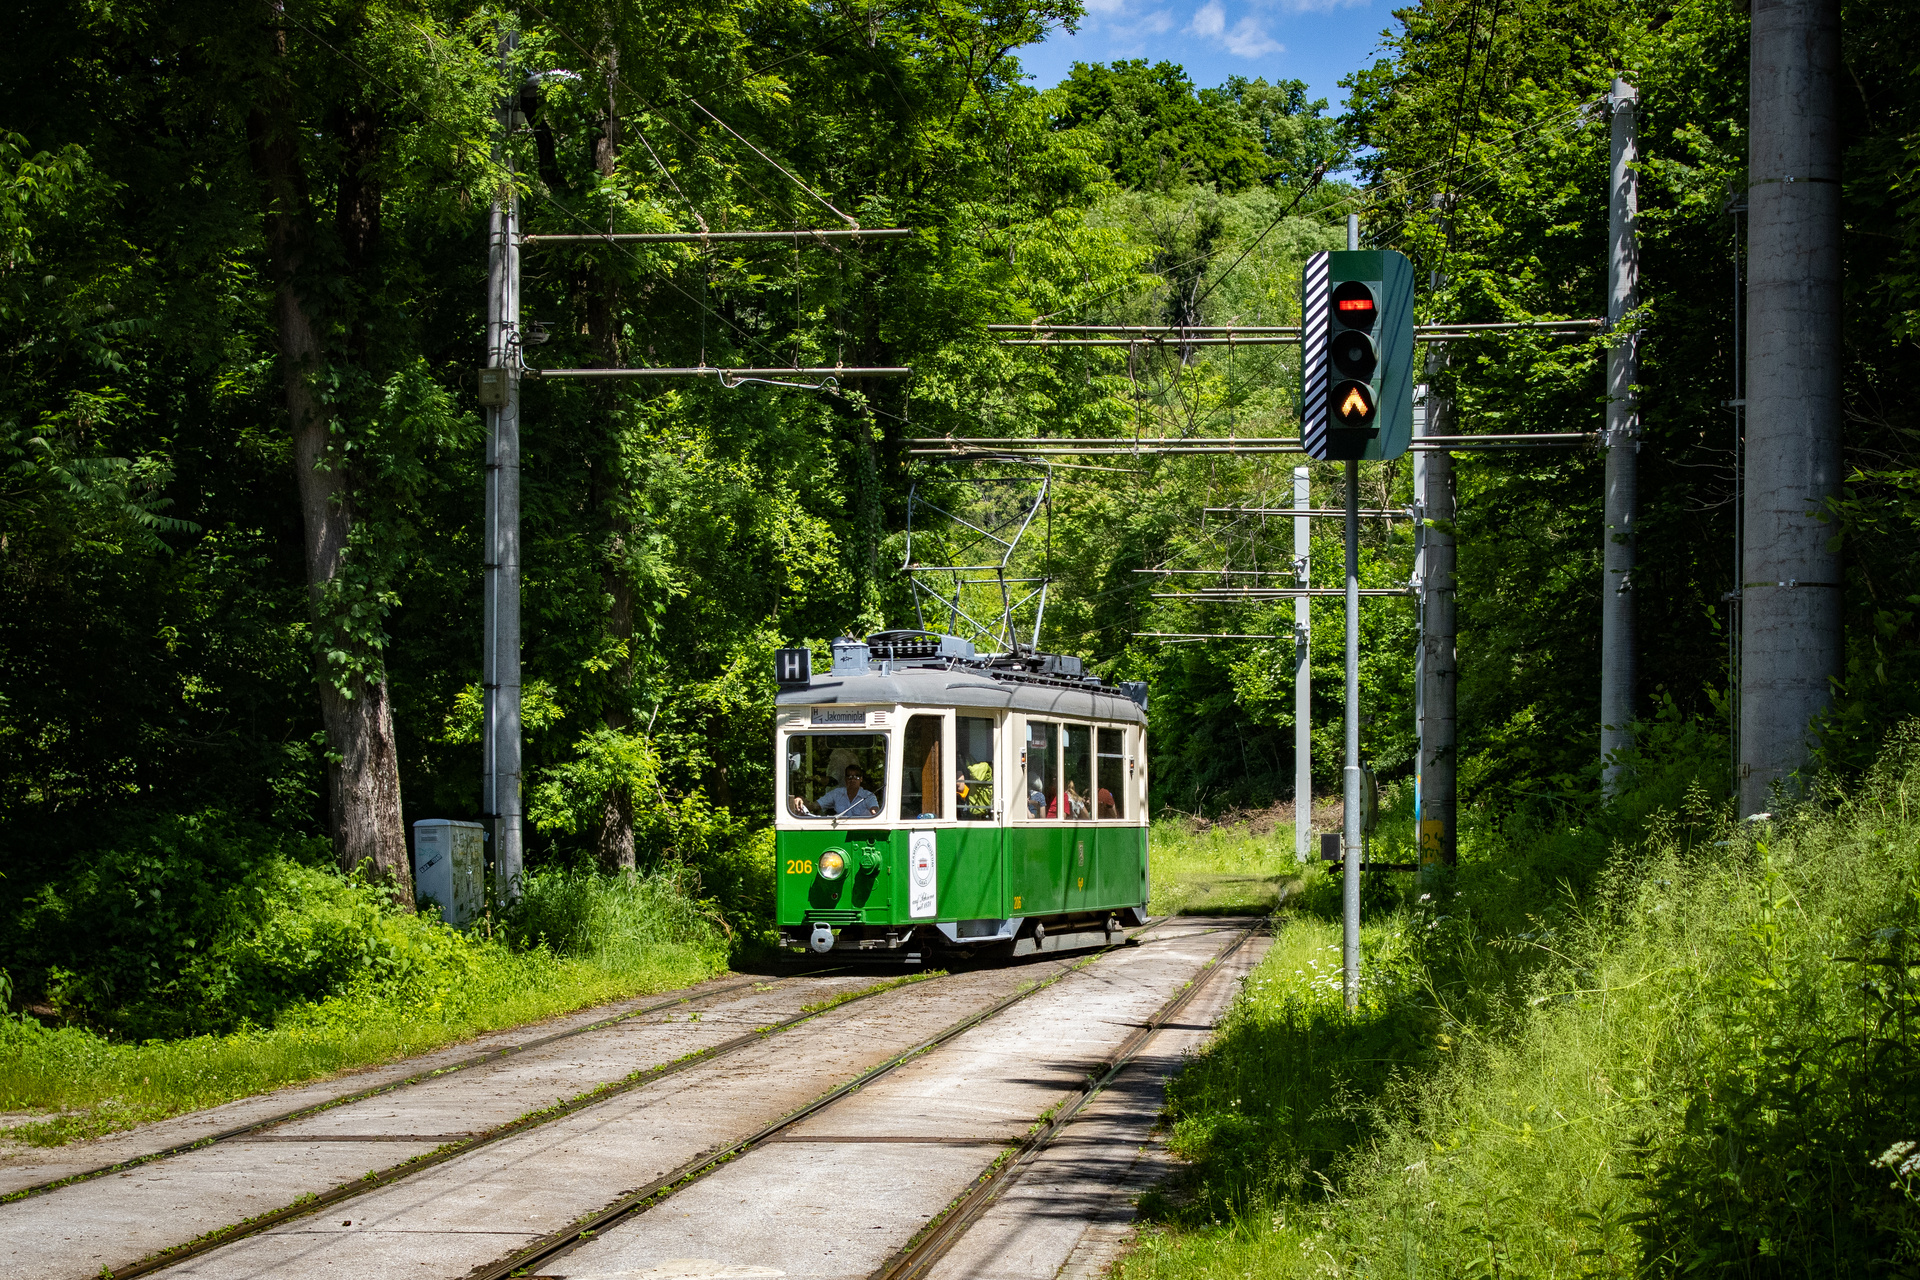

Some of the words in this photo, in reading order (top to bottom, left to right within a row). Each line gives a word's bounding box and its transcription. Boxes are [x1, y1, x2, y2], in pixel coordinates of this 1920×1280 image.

[784, 653, 799, 679] H
[787, 859, 812, 874] 206
[1013, 896, 1022, 909] 206
